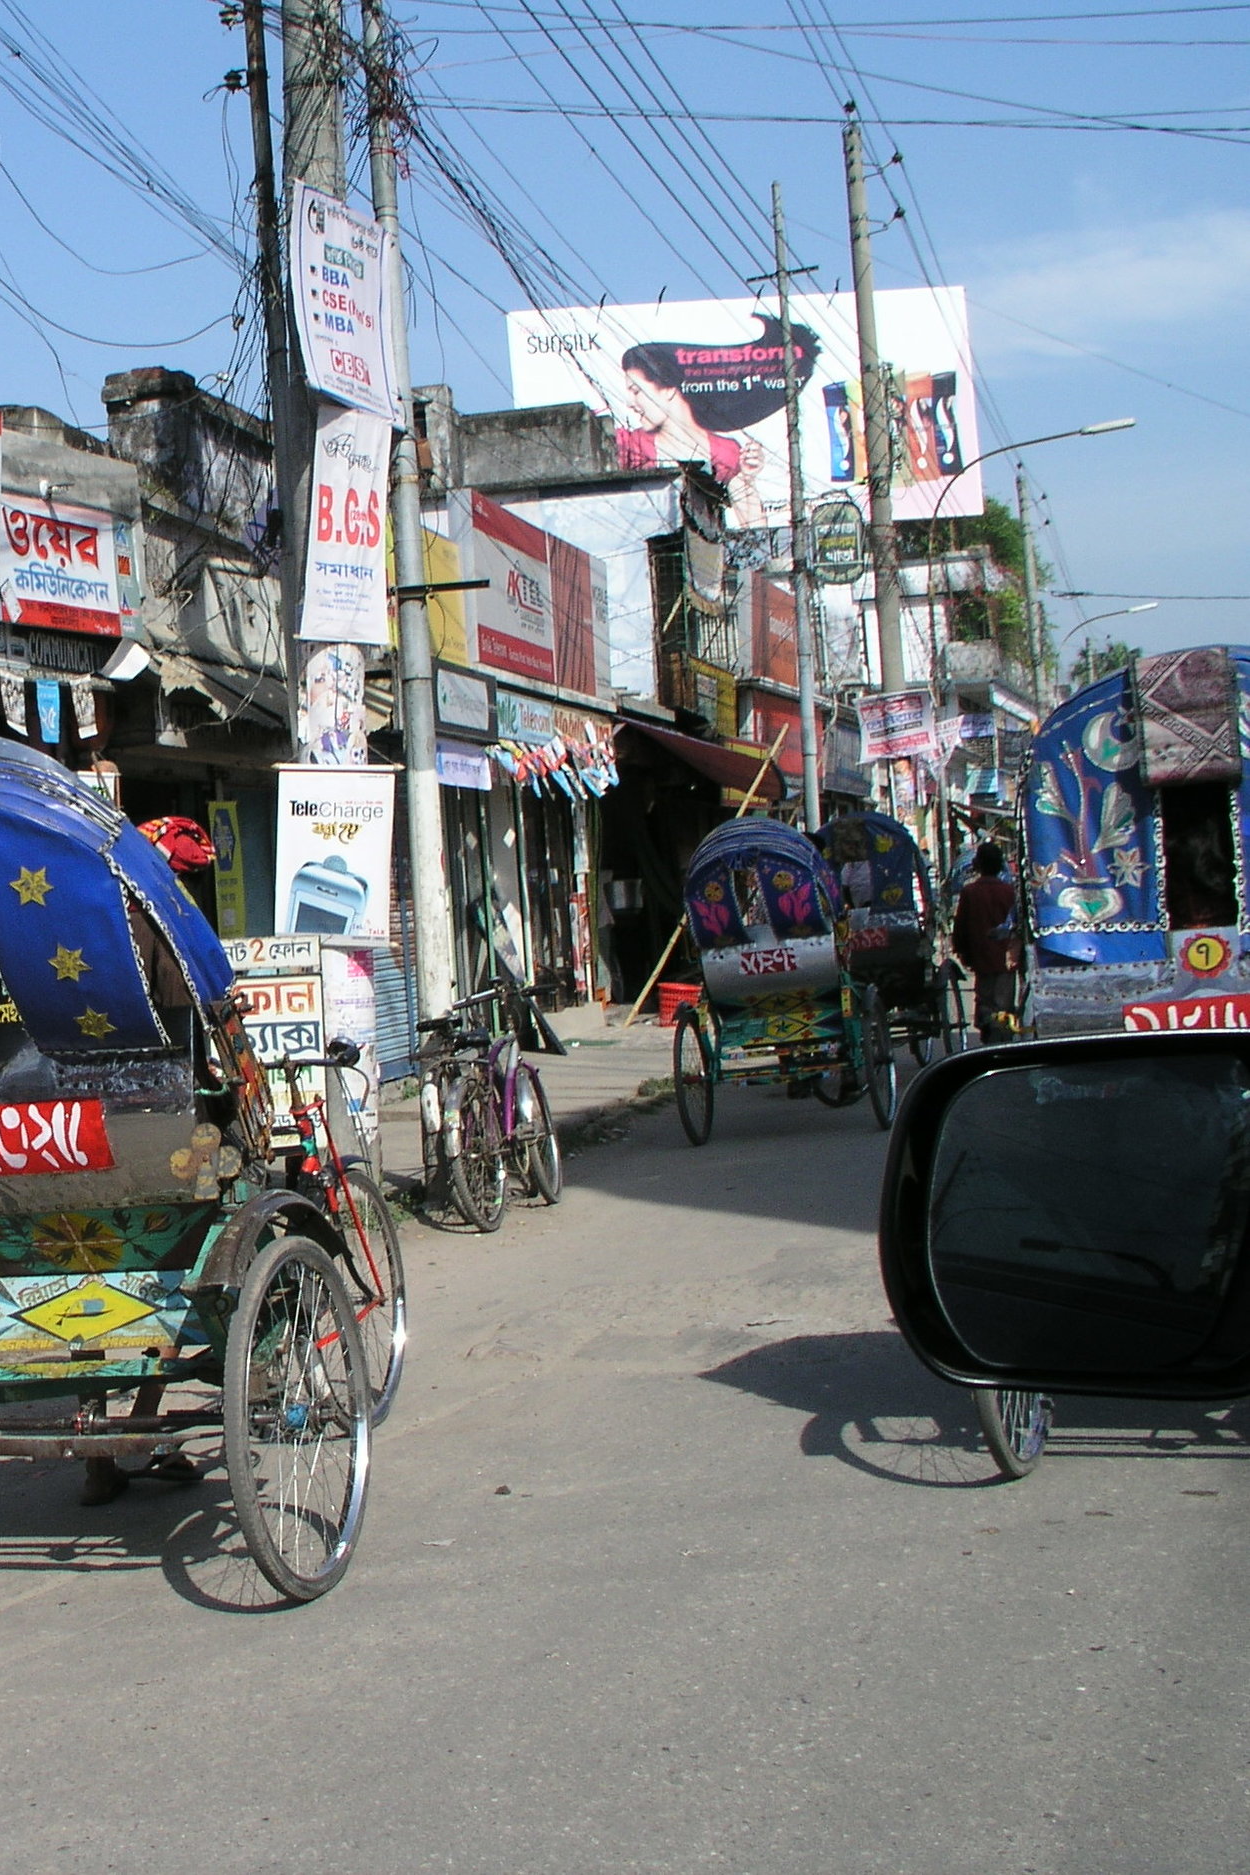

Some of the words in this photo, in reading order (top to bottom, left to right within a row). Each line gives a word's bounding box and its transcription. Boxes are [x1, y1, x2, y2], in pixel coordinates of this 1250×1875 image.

[322, 266, 350, 289] BBA
[325, 312, 354, 336] MBA
[681, 380, 712, 394] from
[716, 378, 739, 392] the
[317, 483, 381, 549] B.C.S
[2, 506, 99, 570] ওয়েব
[13, 561, 110, 604] কমিউনিকেশন
[289, 799, 384, 822] TeleCharge
[251, 938, 266, 963] 2
[269, 941, 312, 960] ফোন
